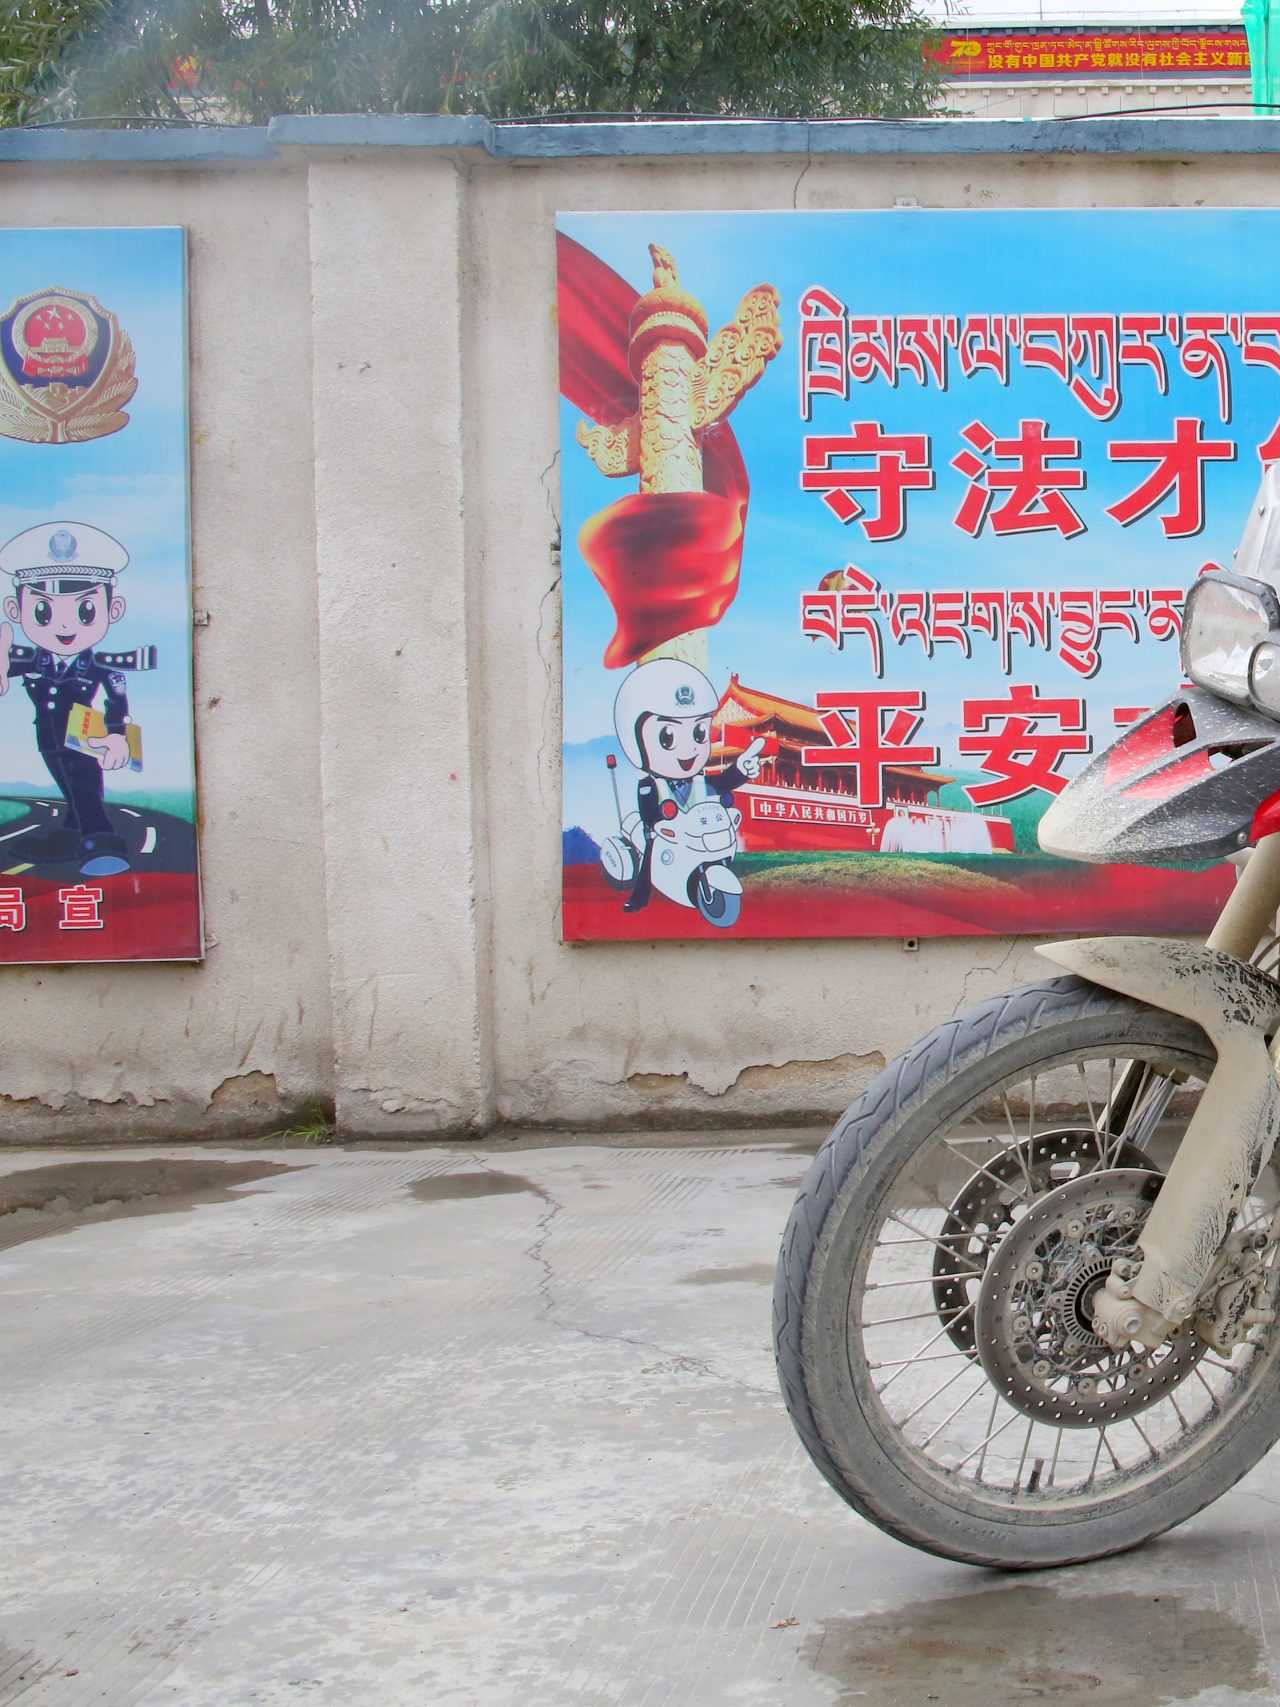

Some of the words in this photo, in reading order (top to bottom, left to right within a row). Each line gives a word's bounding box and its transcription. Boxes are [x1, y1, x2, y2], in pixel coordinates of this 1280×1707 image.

[802, 685, 1163, 808] 平安
[759, 801, 868, 824] 中华人民共和国万岁
